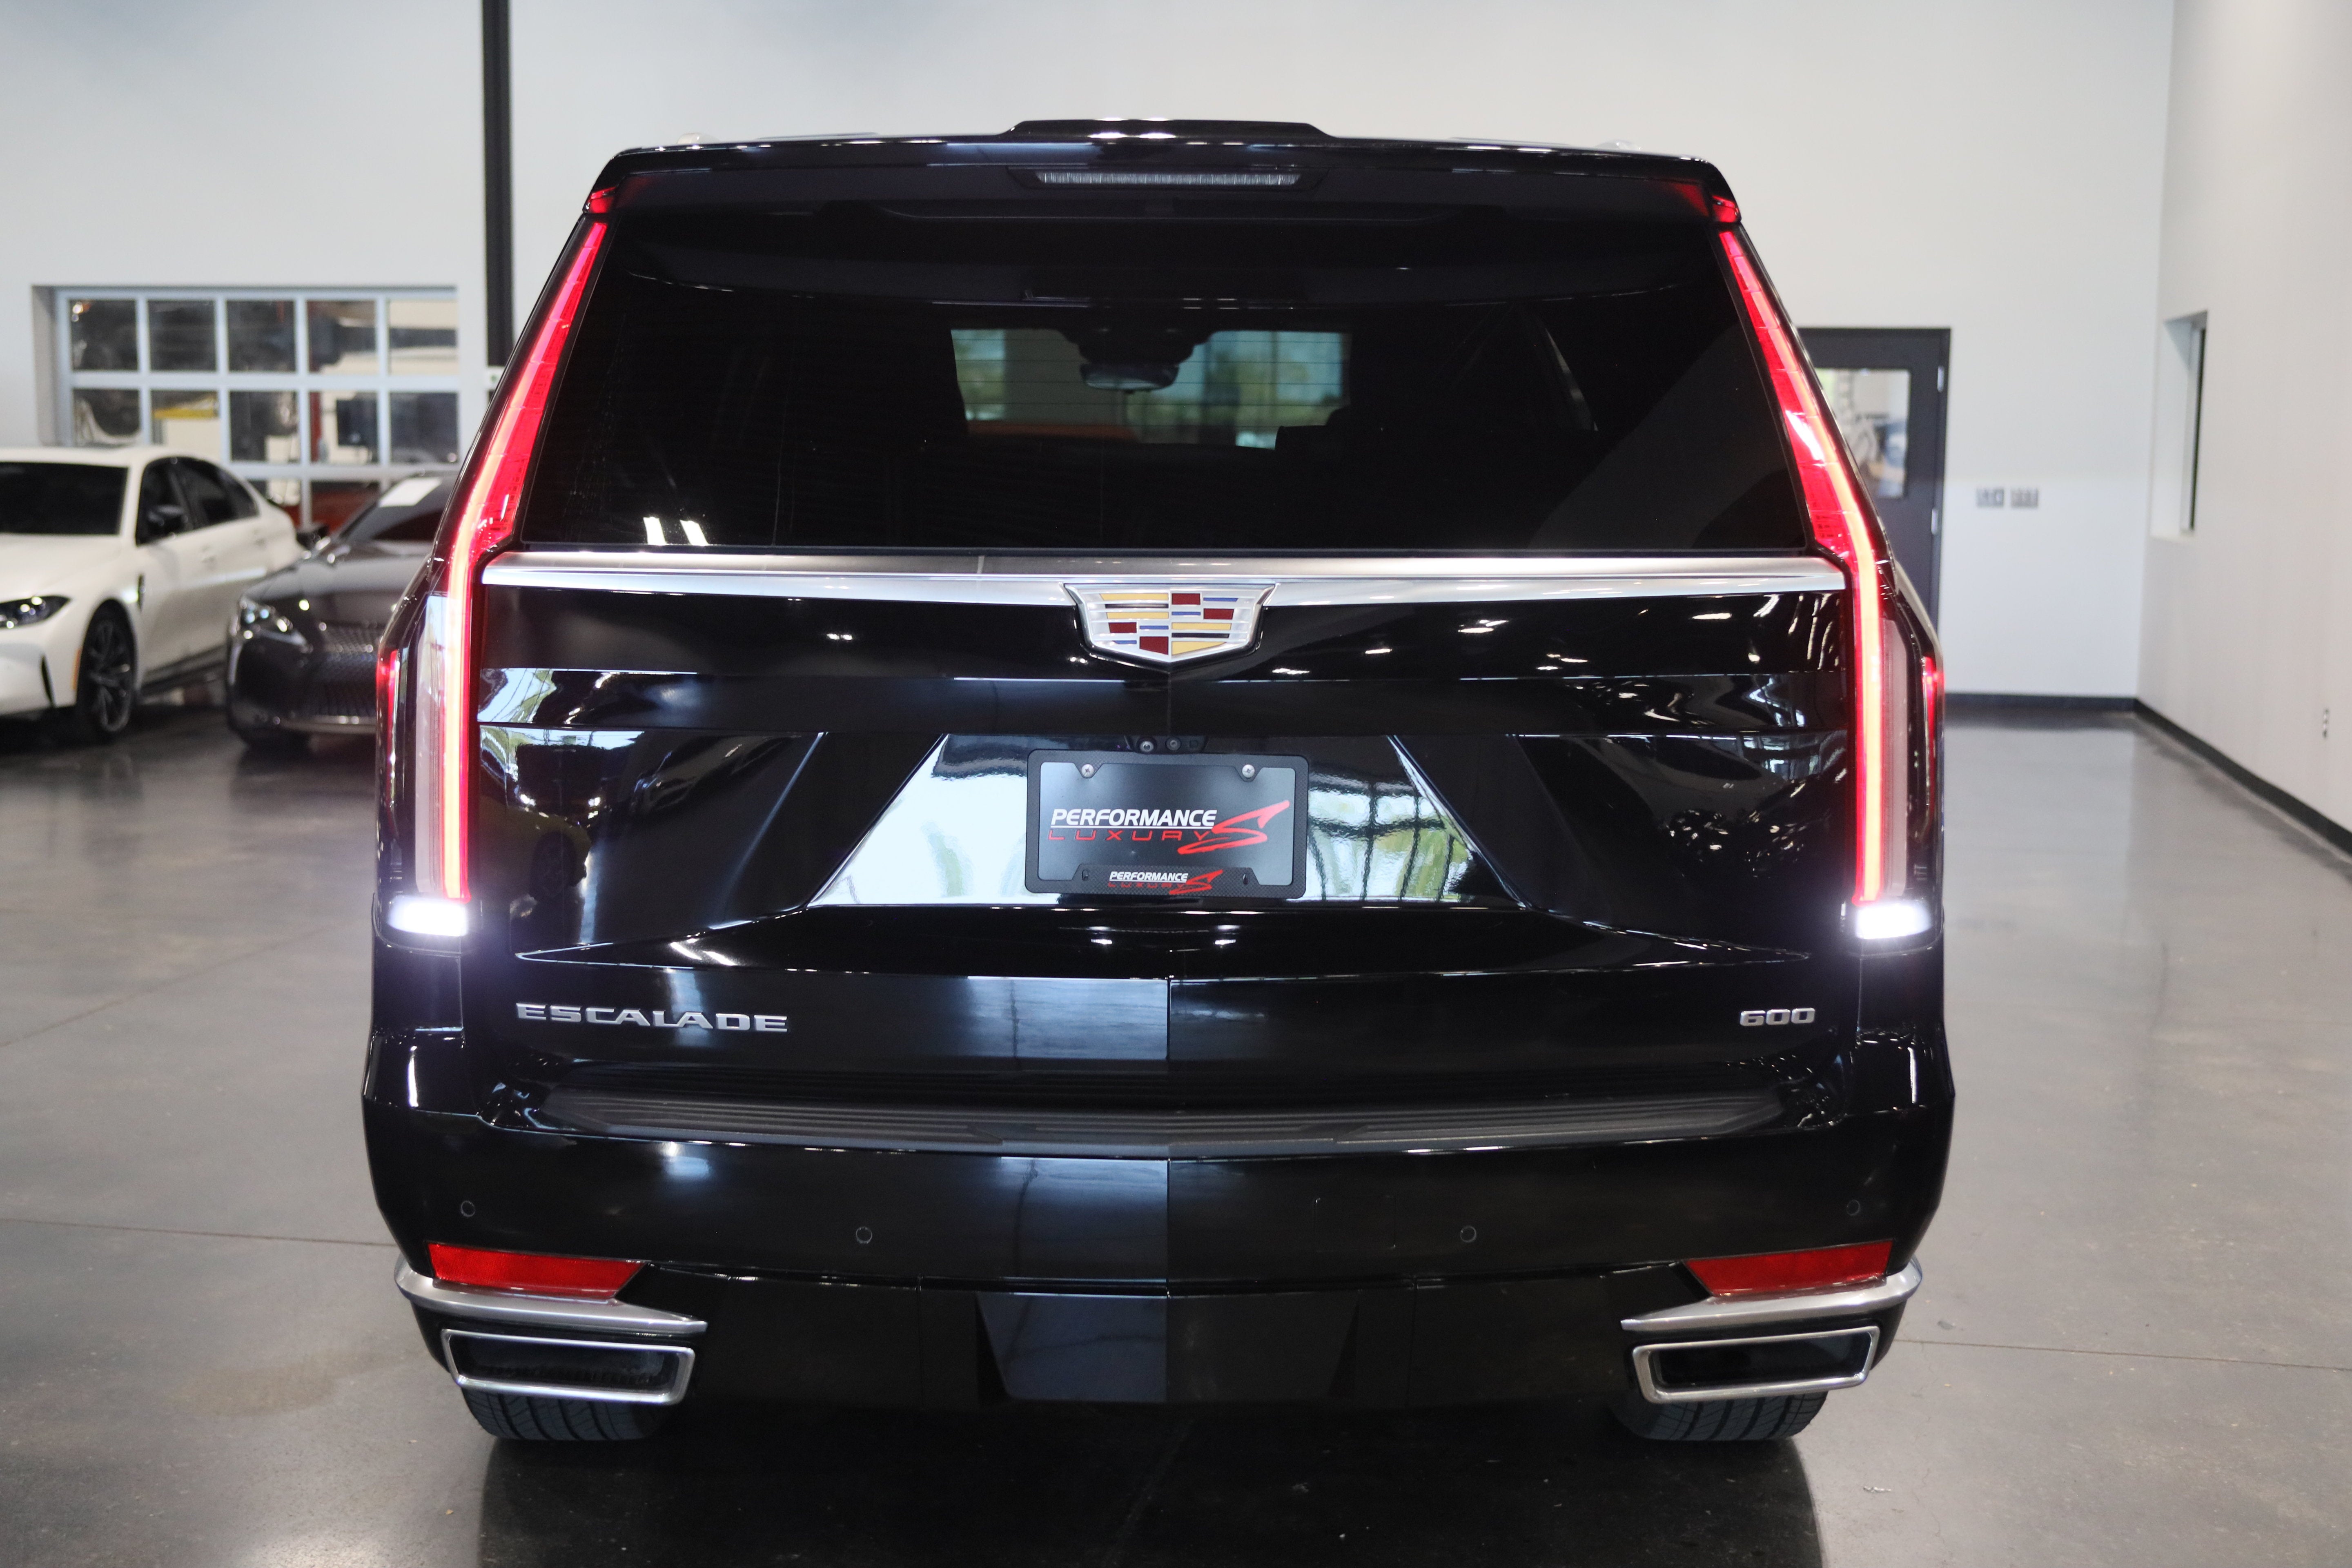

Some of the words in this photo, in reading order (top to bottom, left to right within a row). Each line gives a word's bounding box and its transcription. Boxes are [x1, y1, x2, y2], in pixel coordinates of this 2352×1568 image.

[1051, 808, 1217, 826] PERFORMANCE
[1048, 829, 1210, 841] LUXURY
[1109, 871, 1189, 882] PERFORMANCE
[516, 1002, 788, 1032] ESCALADE
[1740, 1007, 1815, 1027] 600
